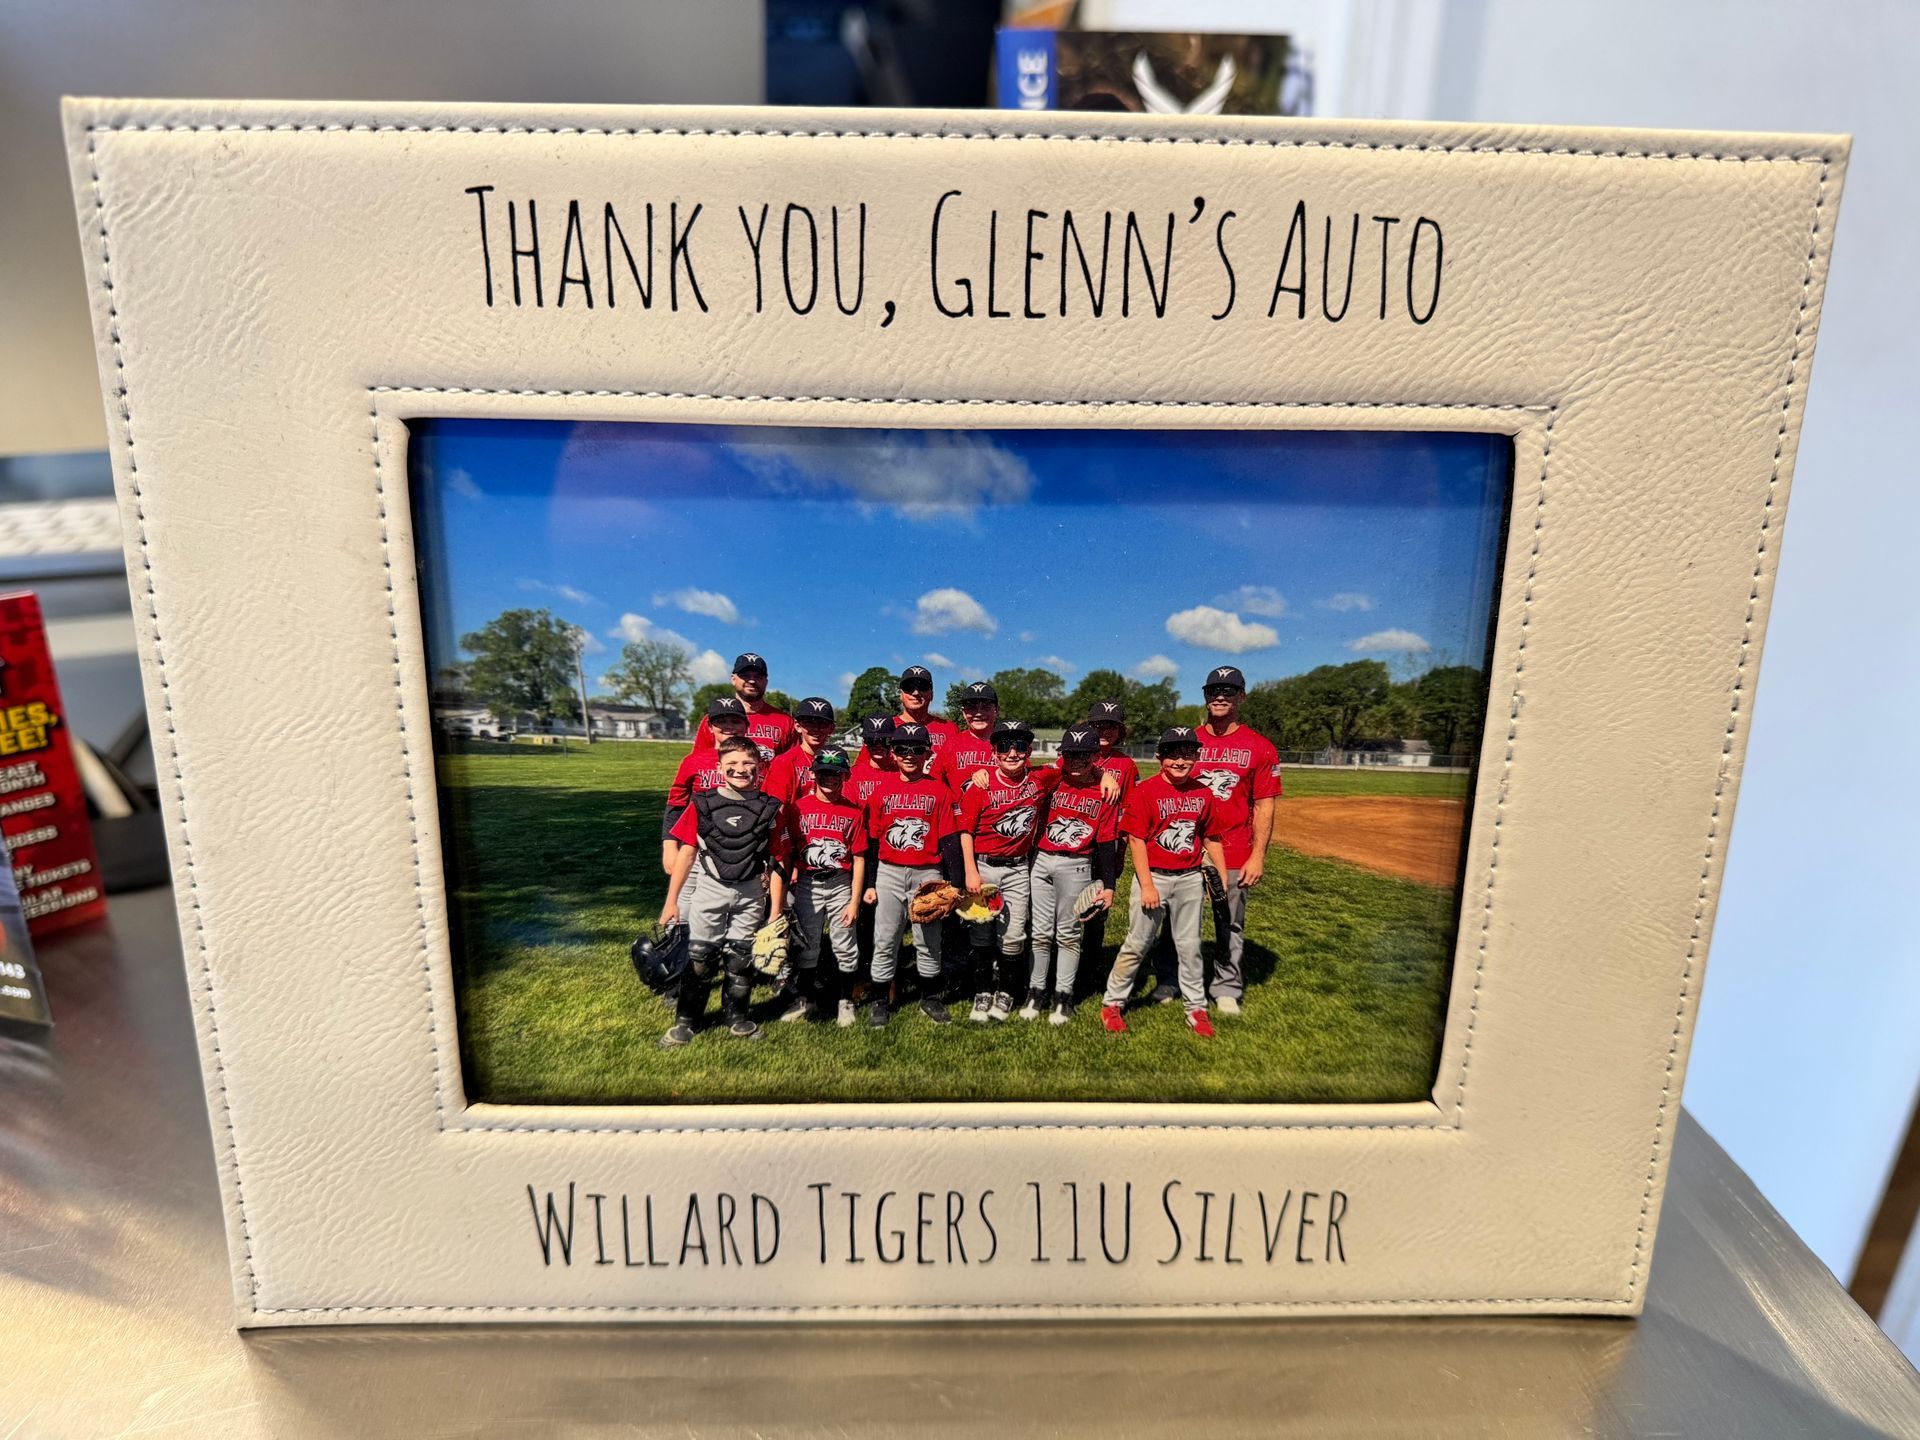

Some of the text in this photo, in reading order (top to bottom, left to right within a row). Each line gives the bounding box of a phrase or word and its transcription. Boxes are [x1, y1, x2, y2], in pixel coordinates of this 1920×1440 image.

[465, 185, 1444, 327] THANK YOU, GLENN'S AUTO
[883, 794, 936, 816] WILLARD
[1050, 791, 1102, 819] WILLARD
[527, 1180, 1348, 1267] WILLARD TIGERS 11U SILVER
